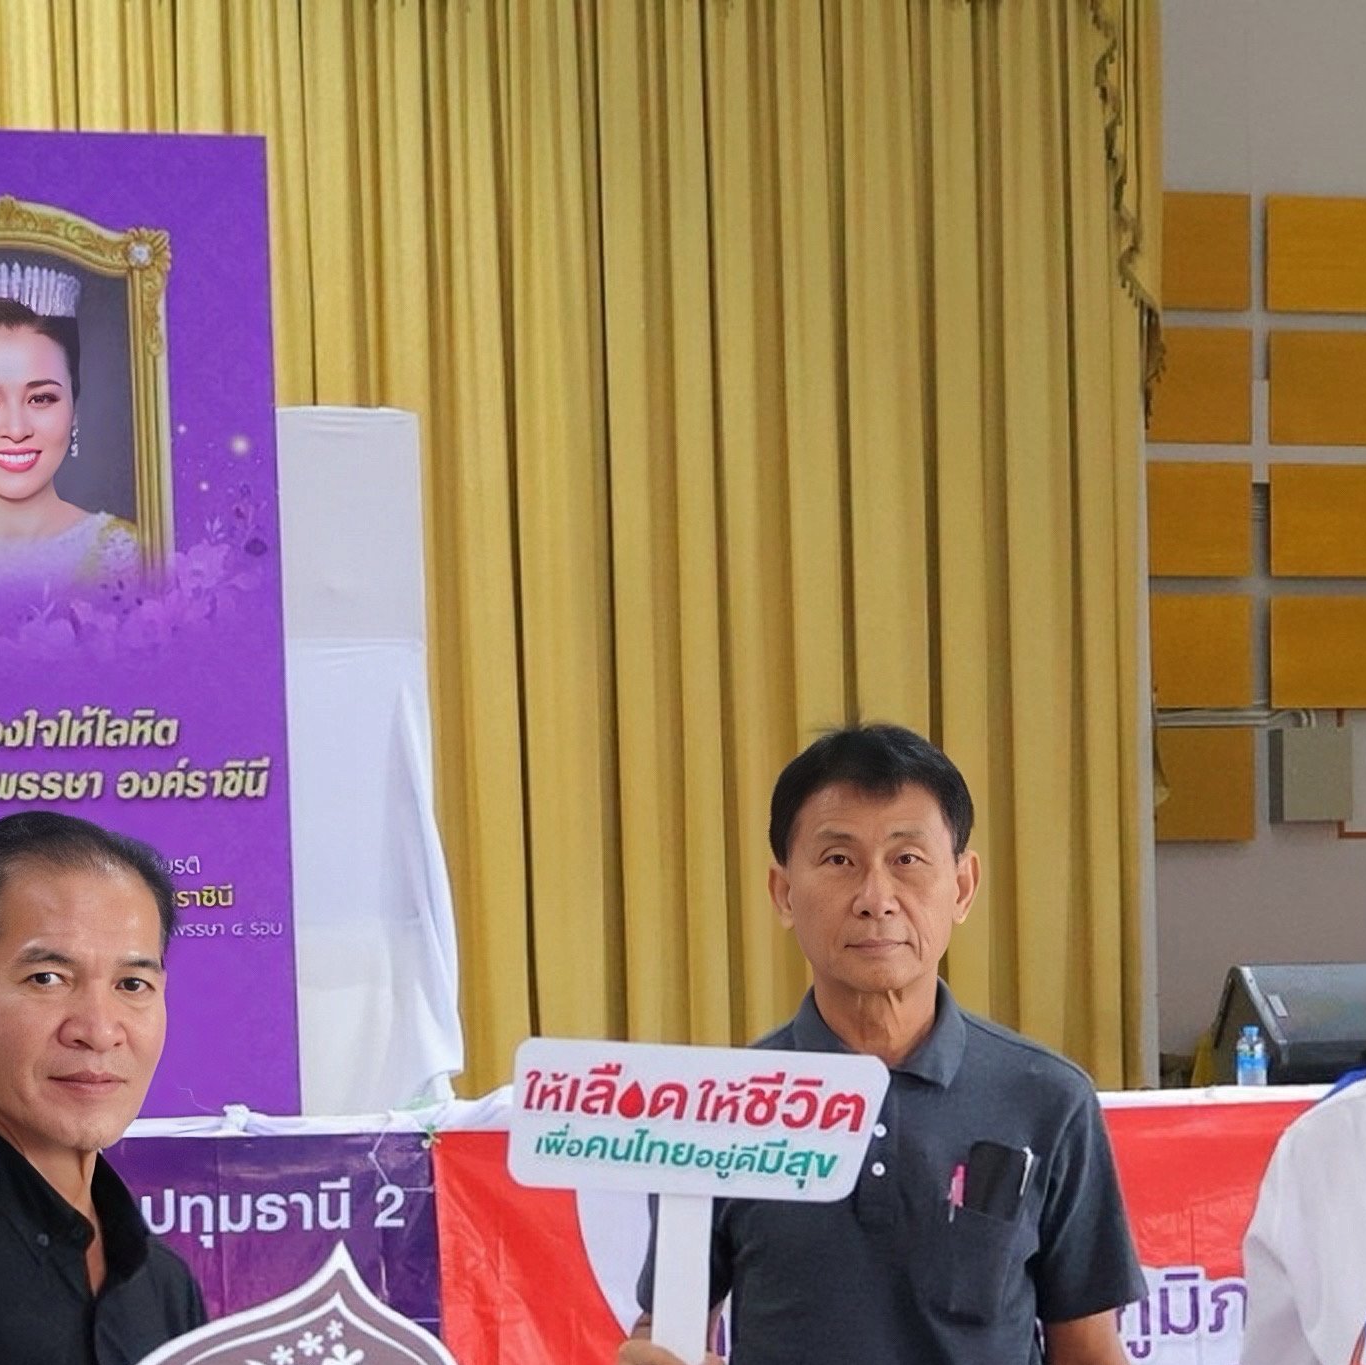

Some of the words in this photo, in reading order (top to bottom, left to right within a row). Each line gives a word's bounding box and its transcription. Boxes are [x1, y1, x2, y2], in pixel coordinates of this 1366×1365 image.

[115, 757, 272, 800] องค์ราชินี
[172, 884, 233, 908] ราชินี
[534, 1123, 839, 1189] เพื่อคนไทยอยู่ดีมีสุข
[140, 1177, 351, 1249] ปทุมธานี
[373, 1184, 406, 1228] 2
